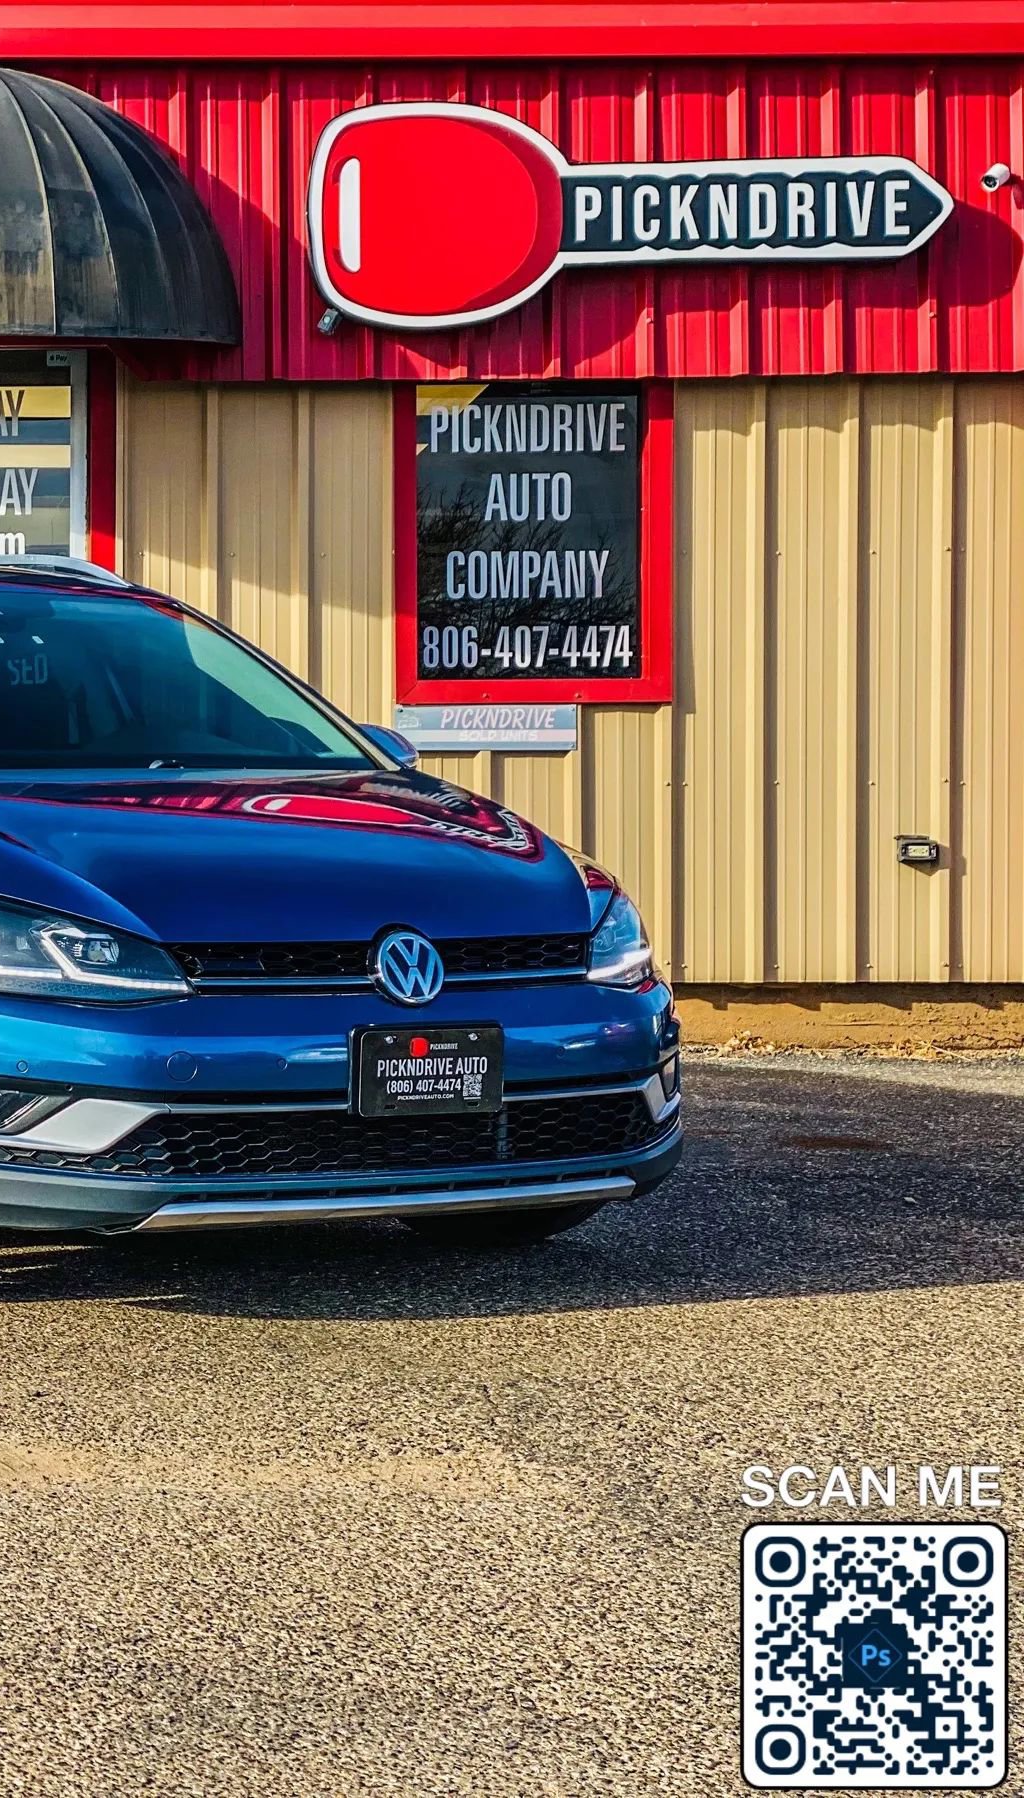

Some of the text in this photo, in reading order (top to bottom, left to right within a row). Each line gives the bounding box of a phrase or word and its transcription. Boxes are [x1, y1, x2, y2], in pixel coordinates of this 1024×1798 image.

[575, 179, 910, 242] PICKNDRIVE
[430, 403, 626, 453] PICKNDRIVE
[484, 471, 572, 521] AUTO
[446, 550, 609, 600] COMPANY
[423, 625, 633, 669] 806-407-4474
[440, 708, 556, 729] PICKNDRIVE
[459, 731, 538, 742] SOLD UNITS
[377, 1057, 488, 1077] PICKNDRIVE AUTO
[387, 1078, 462, 1094] (806) 407-4474
[397, 1093, 455, 1101] PICKNDRIVEAUTO.COM
